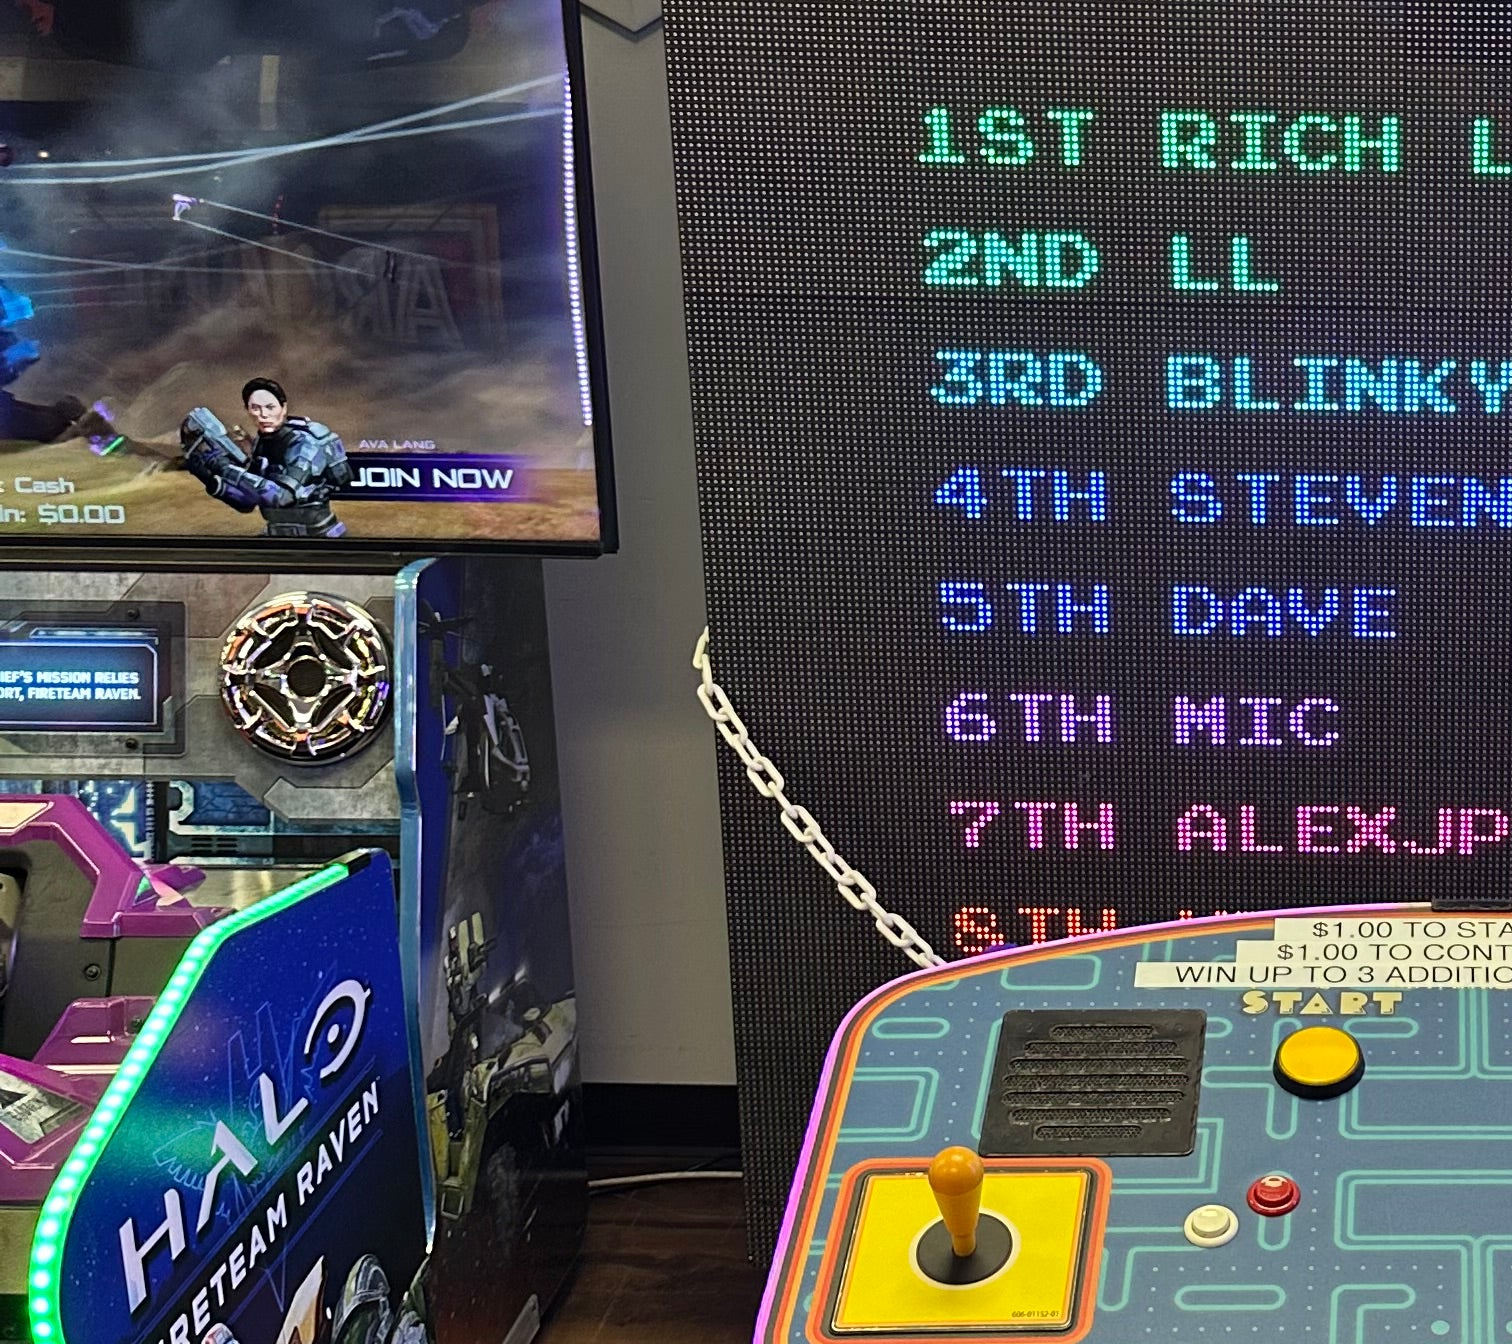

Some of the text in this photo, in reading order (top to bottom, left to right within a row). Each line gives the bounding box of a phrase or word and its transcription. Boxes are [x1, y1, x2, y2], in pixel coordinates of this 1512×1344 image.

[918, 107, 1094, 168] 1ST
[1160, 111, 1399, 173] RICH
[921, 230, 1280, 292] 2ND LL
[930, 351, 1102, 408] 3RD
[359, 439, 436, 450] AVA LANG
[14, 476, 75, 494] Cash
[350, 467, 513, 489] JOIN NOW
[933, 466, 1107, 522] 4TH
[37, 502, 126, 526] $0.00
[939, 580, 1398, 639] 5TH DAVE
[0, 670, 139, 684] IEF'S MISSION RELIES
[27, 687, 91, 700] FIRETEAM
[944, 691, 1340, 747] 6TH MIC
[949, 800, 1511, 856] 7TH ALEXJP
[1312, 921, 1393, 938] $1.00
[1402, 921, 1447, 938] TO
[1276, 943, 1358, 961] $1.00
[1368, 944, 1413, 961] TO
[1175, 965, 1237, 983] WIN
[1249, 965, 1293, 983] UP
[1303, 966, 1348, 983] TO
[1357, 966, 1375, 983] 3
[1242, 990, 1403, 1015] START
[119, 979, 371, 1314] HALO
[297, 1082, 379, 1206] RAVEN
